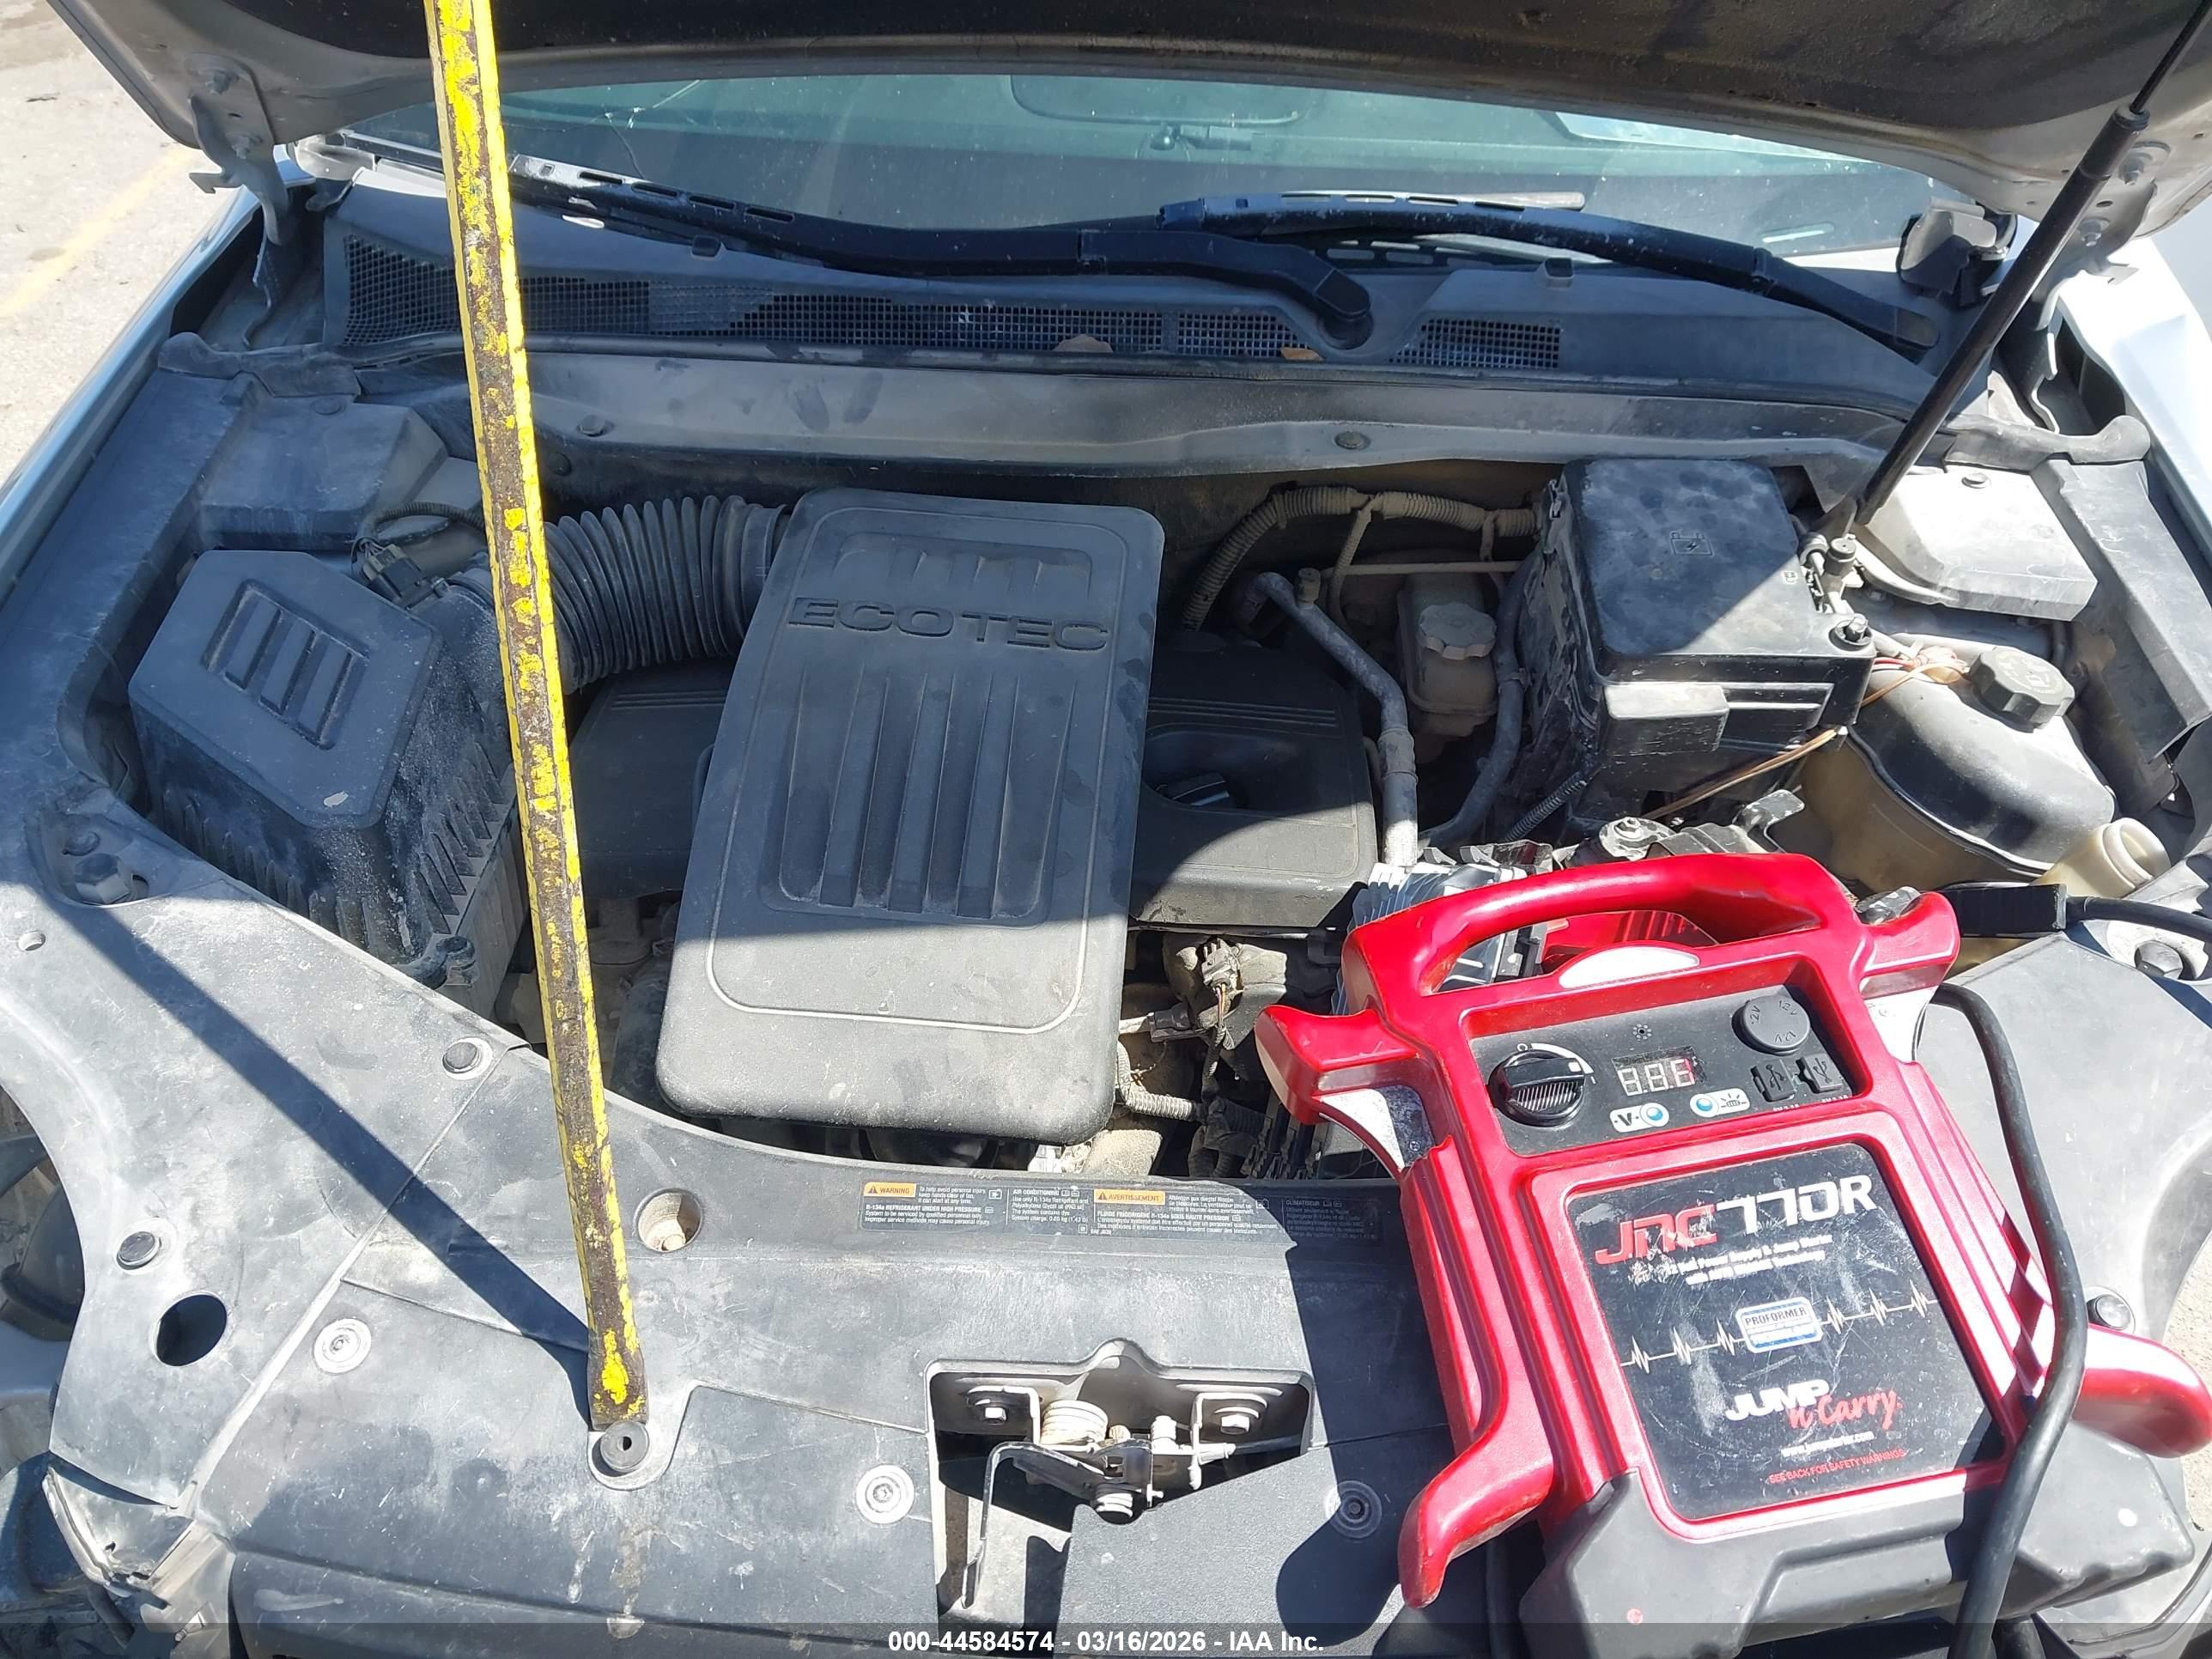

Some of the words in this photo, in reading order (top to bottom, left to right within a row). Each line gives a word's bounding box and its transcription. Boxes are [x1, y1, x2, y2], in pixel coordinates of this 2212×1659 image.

[788, 597, 1109, 652] ECOTEC
[1109, 1194, 1160, 1202] AVERTISSEMENT
[1745, 1306, 1808, 1326] PROFORMER
[1725, 1379, 1830, 1421] JUMP
[1769, 1473, 1787, 1484] SEE
[1787, 1468, 1810, 1480] BACK
[1811, 1464, 1828, 1476] FOR
[1829, 1457, 1861, 1472] SAFETY
[1861, 1449, 1905, 1465] WARNINGS
